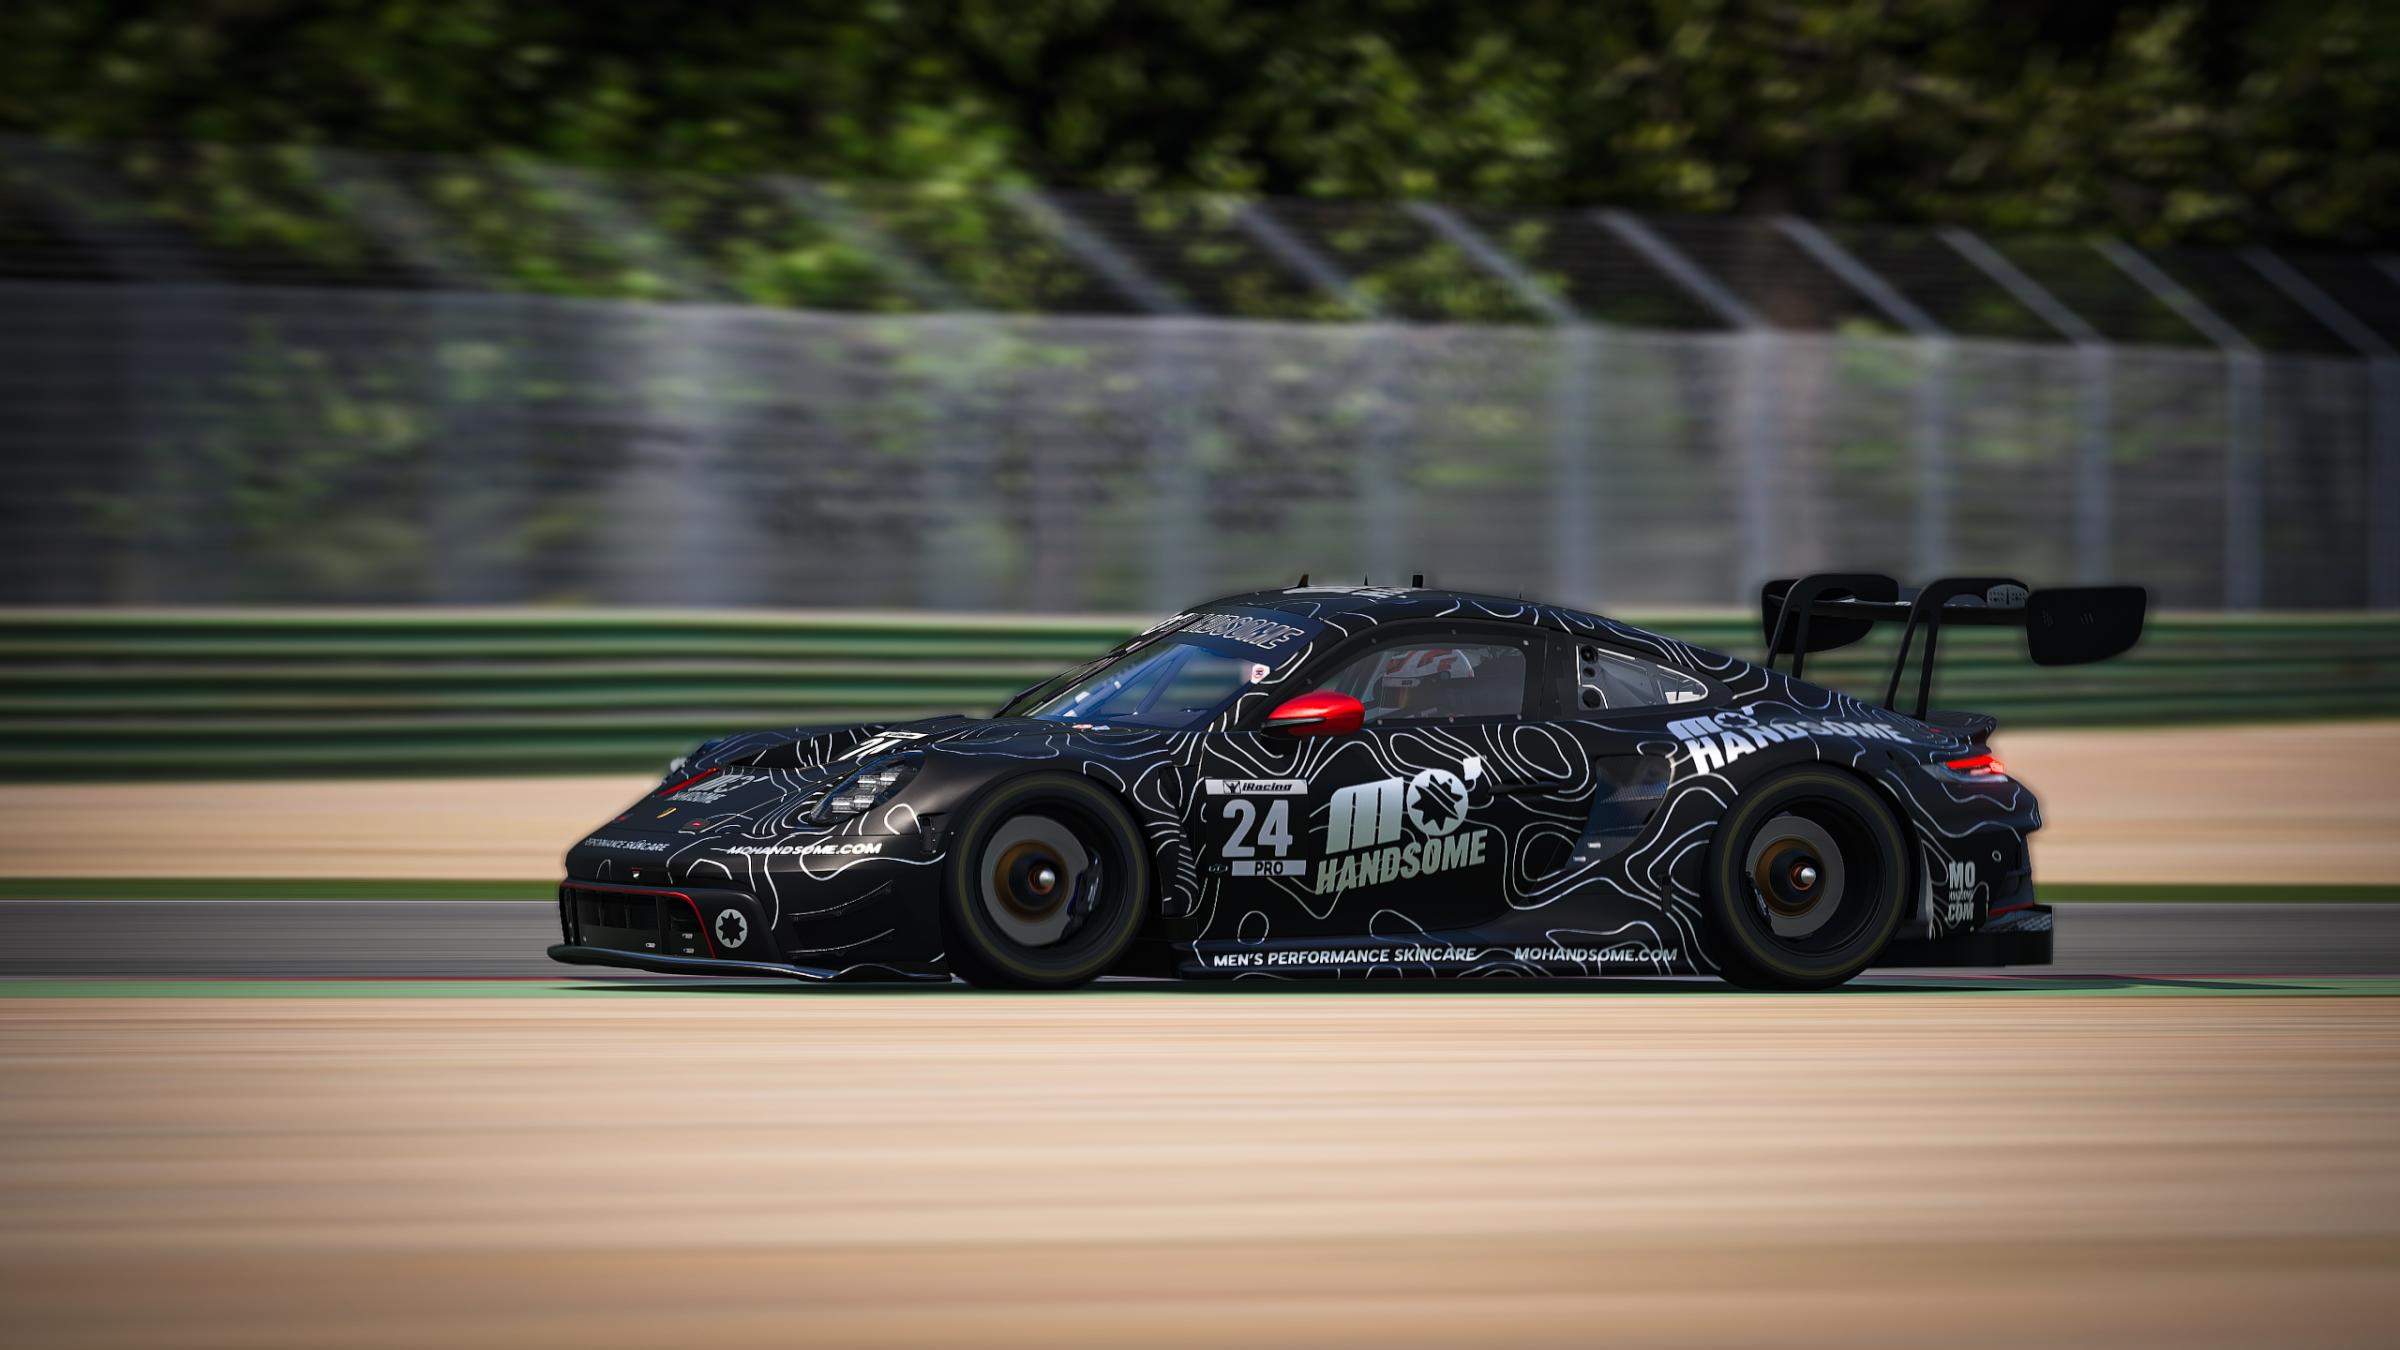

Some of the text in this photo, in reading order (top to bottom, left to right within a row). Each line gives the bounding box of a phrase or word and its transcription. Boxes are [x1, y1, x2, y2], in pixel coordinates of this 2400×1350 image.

[1685, 720, 1912, 776] HANDSOME
[1242, 782, 1293, 792] iRacing
[1222, 799, 1293, 858] 24
[726, 842, 883, 855] MOHANDSOME.COM
[1255, 861, 1284, 875] PRO
[1315, 829, 1488, 895] HANDSOME
[1949, 861, 1976, 889] MO
[1214, 946, 1477, 967] MEN'S PERFORMANCE SKINCARE
[1514, 946, 1678, 962] MOHANDSOME.COM
